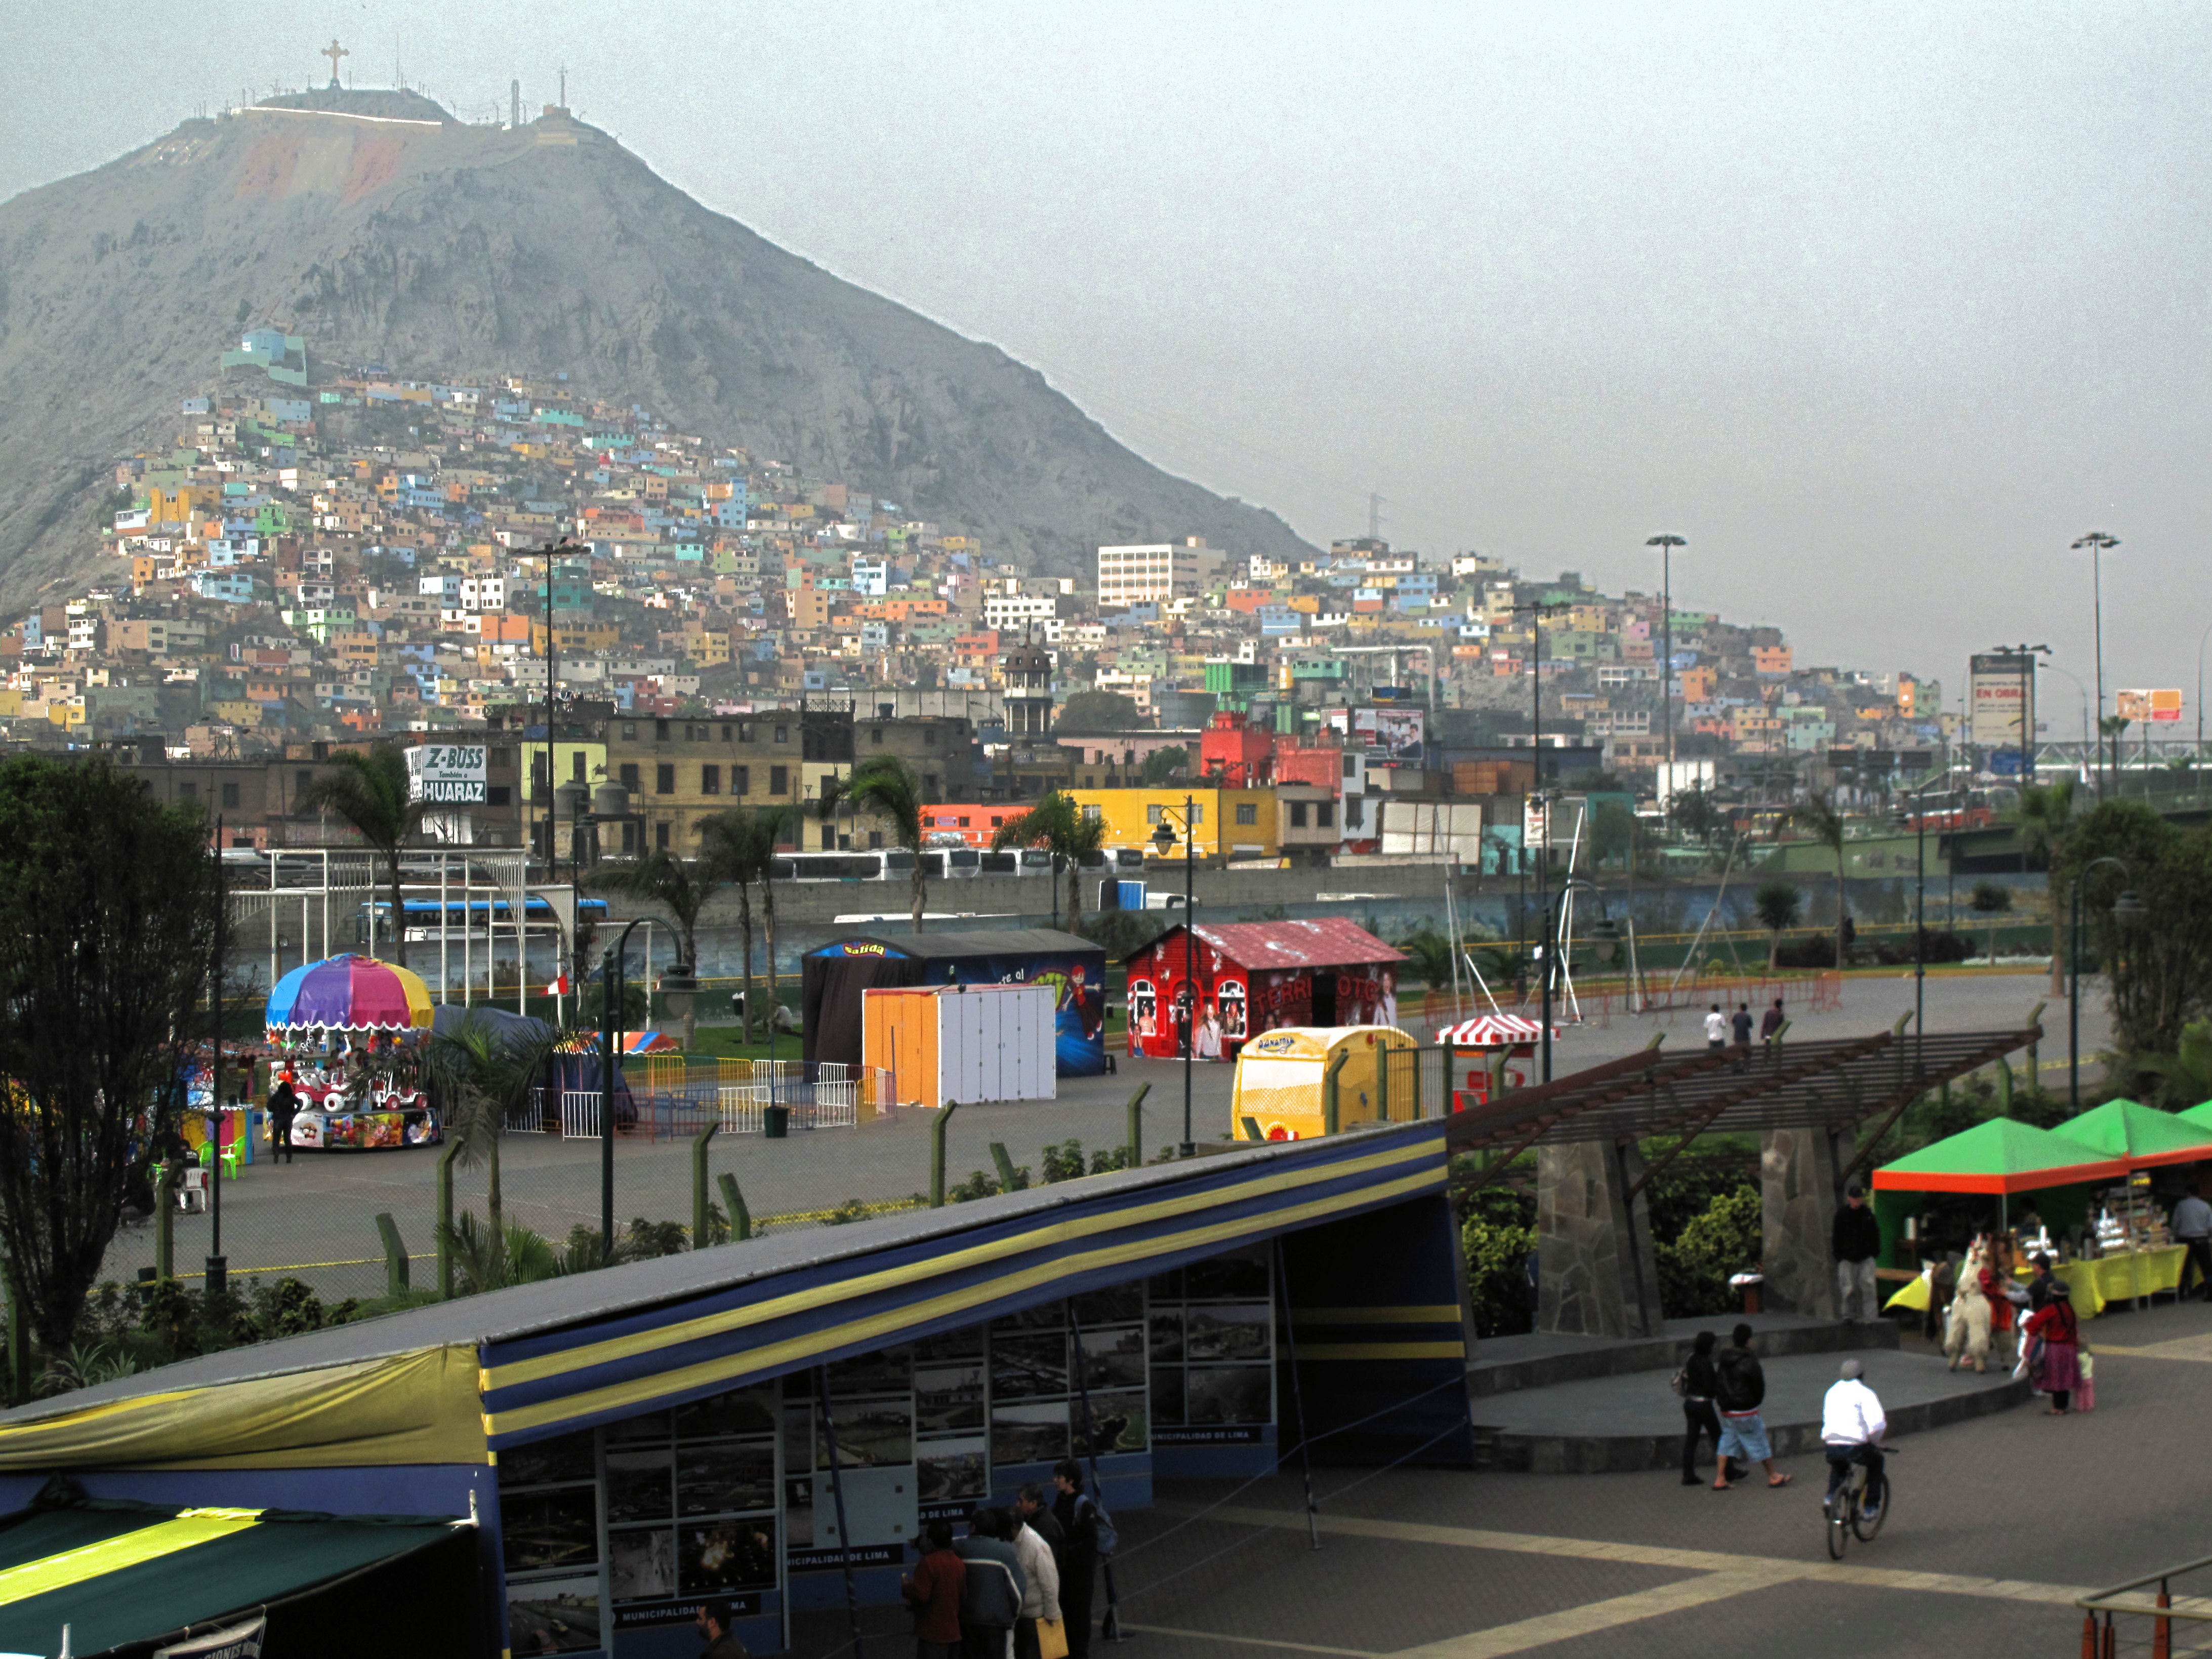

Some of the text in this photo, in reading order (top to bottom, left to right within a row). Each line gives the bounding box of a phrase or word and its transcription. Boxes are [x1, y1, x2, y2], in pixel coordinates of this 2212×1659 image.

[1976, 689, 1992, 698] EN
[425, 748, 483, 768] Z-BUSS
[424, 782, 483, 801] HUARAZ
[844, 944, 885, 956] Salida
[1254, 976, 1378, 1016] TERROTO
[1151, 1432, 1212, 1440] UNICIPALIDAD
[1228, 1431, 1250, 1439] LIMA
[928, 1510, 940, 1519] DE
[943, 1507, 964, 1517] LIMA
[788, 1551, 889, 1566] ICIPALIDA DE LIMA
[729, 1601, 747, 1610] MA
